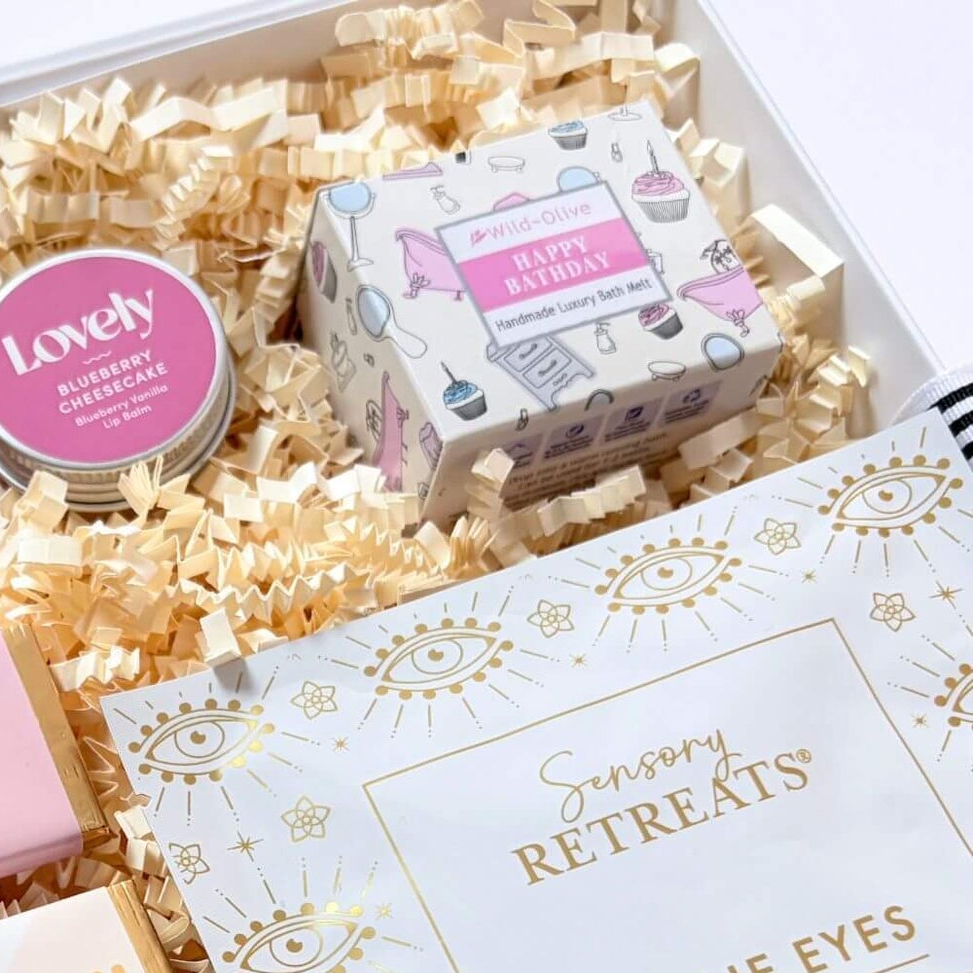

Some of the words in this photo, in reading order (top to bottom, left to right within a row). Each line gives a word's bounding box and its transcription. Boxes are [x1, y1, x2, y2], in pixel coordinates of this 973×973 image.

[503, 251, 611, 296] BATHDAY
[511, 235, 588, 272] HAPPY
[495, 306, 556, 332] Handmade
[559, 295, 596, 314] Luxury
[597, 286, 624, 301] Bath
[626, 278, 652, 294] Melt
[1, 289, 154, 376] Lovely
[56, 349, 152, 397] BLUEBERRY
[58, 362, 168, 414] CHEESECAKE
[74, 401, 129, 427] Blueberry
[131, 384, 168, 405] Vanilla
[102, 414, 120, 430] Lip
[123, 404, 152, 422] Balm
[540, 729, 742, 823] Sensory
